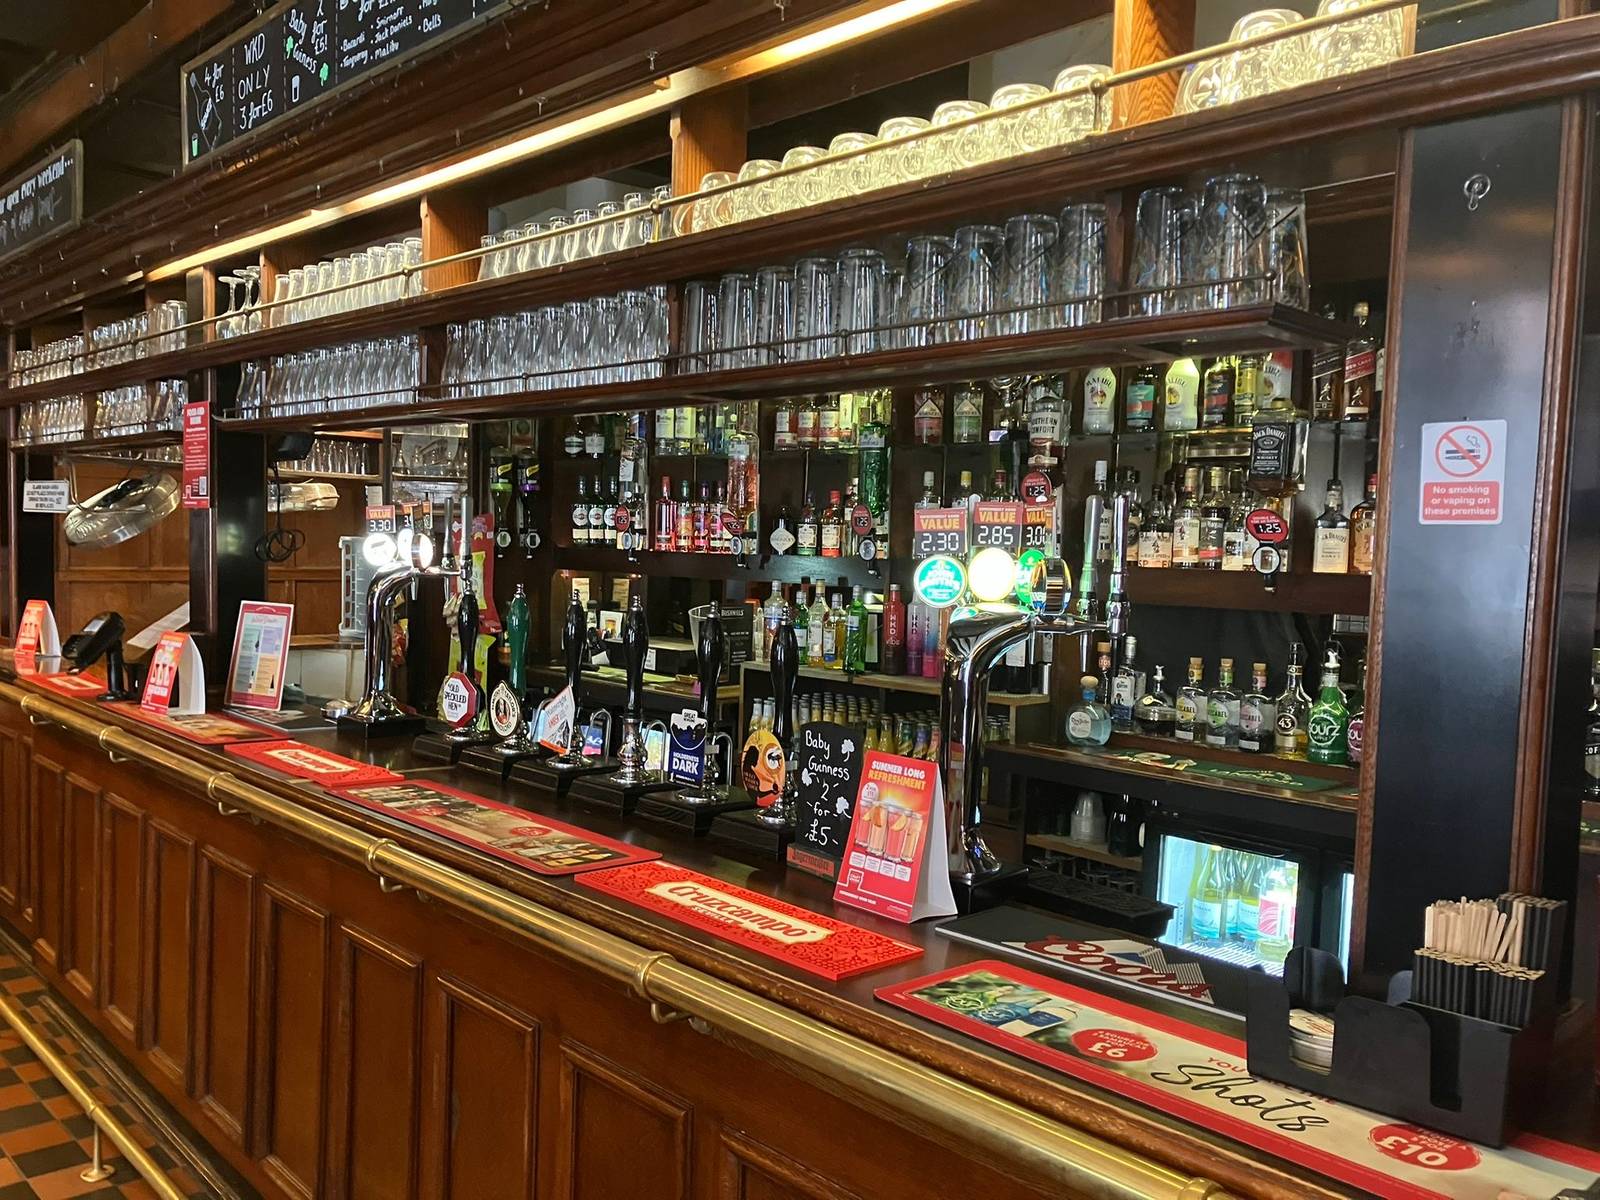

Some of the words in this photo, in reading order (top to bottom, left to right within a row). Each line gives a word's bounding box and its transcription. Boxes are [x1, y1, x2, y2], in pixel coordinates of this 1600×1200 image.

[288, 8, 307, 45] Baby
[311, 19, 327, 44] for
[243, 33, 266, 66] WKD
[314, 33, 328, 56] £5!
[204, 66, 211, 87] 4
[211, 62, 225, 89] for
[238, 63, 271, 100] ONLY
[215, 84, 225, 103] £6
[239, 105, 247, 130] 3
[1432, 485, 1446, 494] No
[1448, 486, 1490, 496] smoking
[1443, 496, 1475, 506] vaping
[979, 511, 1016, 523] VALUE
[1424, 507, 1450, 515] these
[1452, 507, 1496, 516] premises
[369, 520, 391, 532] 3.30
[920, 518, 960, 530] VALUE
[1259, 523, 1282, 534] 1.25
[921, 533, 959, 551] 2.30
[977, 526, 1014, 545] 2.85
[889, 614, 897, 636] WKD
[1278, 718, 1292, 729] 43
[805, 730, 831, 760] Baby
[672, 758, 699, 775] DARK
[808, 755, 850, 781] Guinness
[871, 760, 903, 775] SUMMER
[903, 766, 926, 780] LONG
[867, 769, 927, 791] REFRESHMENT
[820, 783, 830, 802] 2
[813, 801, 831, 817] for
[808, 818, 832, 846] £5
[667, 884, 808, 937] Cruzcampo
[1087, 1042, 1129, 1058] £6
[1150, 1064, 1330, 1132] Shots
[1376, 1135, 1449, 1166] £10
